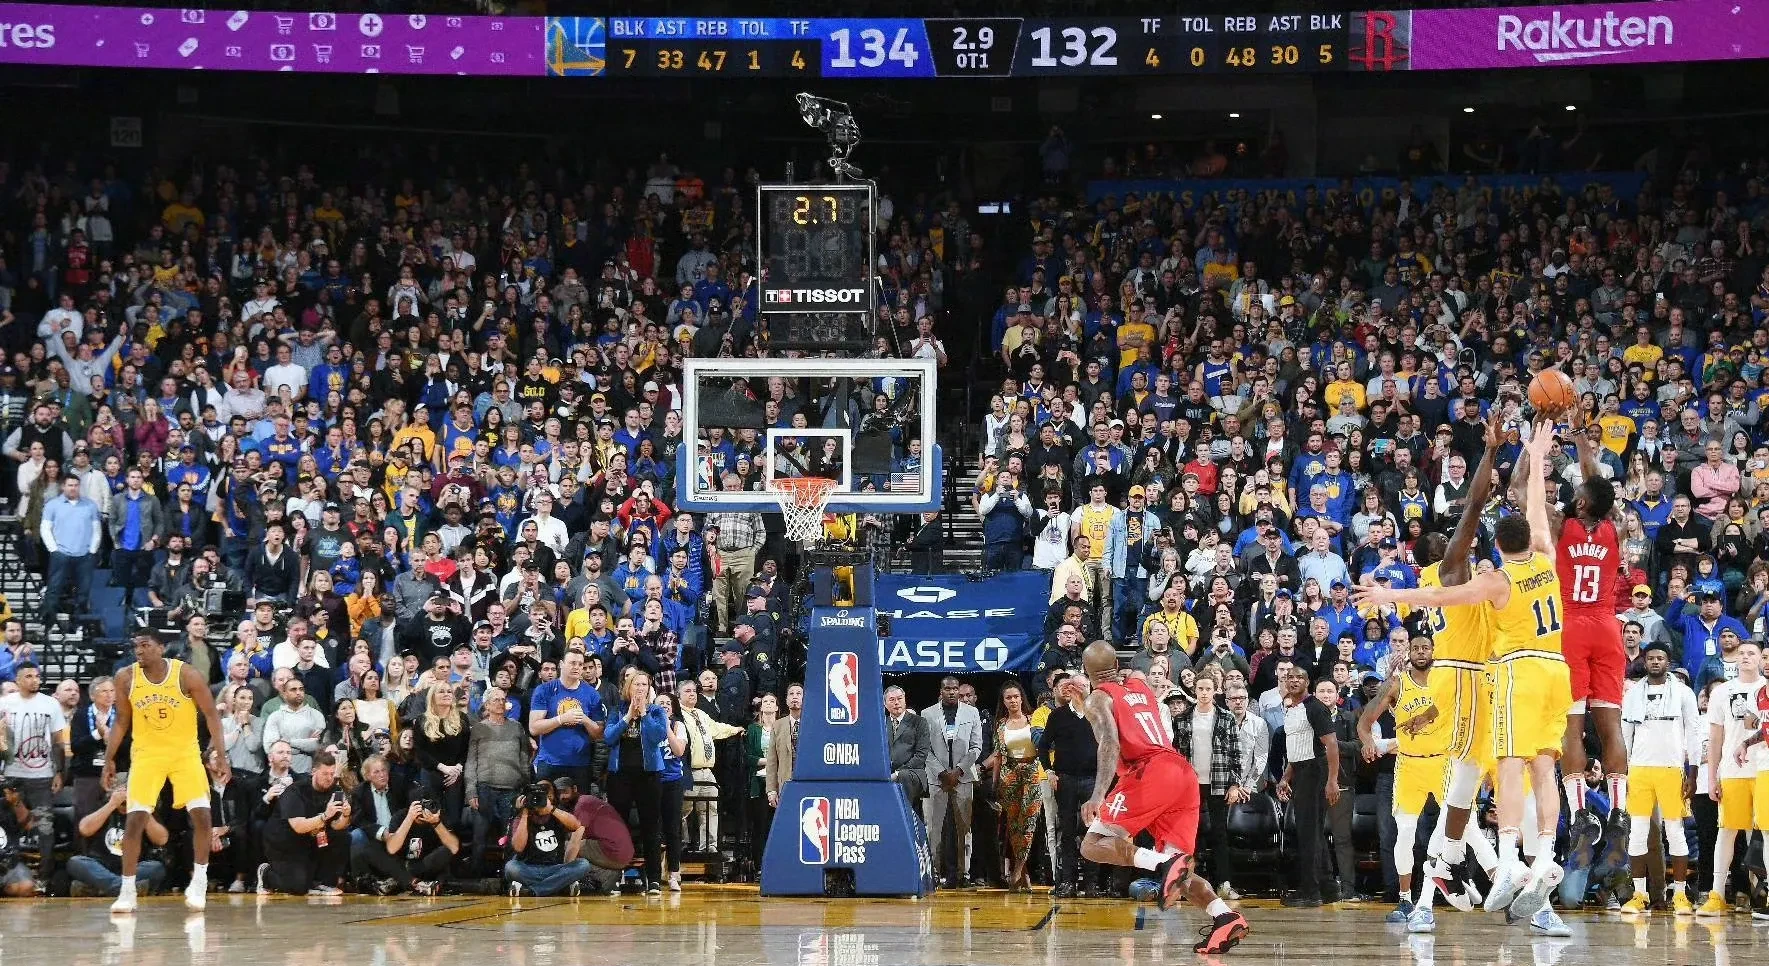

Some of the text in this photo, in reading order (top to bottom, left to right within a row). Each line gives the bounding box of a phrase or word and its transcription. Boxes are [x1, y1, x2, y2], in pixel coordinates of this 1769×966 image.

[613, 20, 810, 36] BLK AST REB TOL TF
[1140, 14, 1342, 34] TF TOL REB AST BLK
[1497, 11, 1674, 51] Rakuten
[829, 27, 919, 68] 134
[952, 26, 994, 50] 2.9
[1030, 26, 1118, 67] 132
[622, 49, 807, 71] 7 33 47 1 4
[1145, 44, 1334, 67] 4 0 48 30 5
[793, 196, 837, 225] 2.7
[792, 289, 865, 303] TISSOT
[1567, 543, 1609, 561] HARDEN
[1515, 569, 1556, 594] THOMPSON
[1571, 564, 1601, 603] 13
[820, 616, 865, 628] SPALDING
[875, 608, 1016, 619] HASE
[1531, 595, 1561, 637] 11
[878, 640, 967, 668] ASE
[158, 707, 168, 719] 5
[830, 707, 846, 720] NBA
[1133, 711, 1164, 746] 17
[823, 742, 860, 766] @NBA
[834, 798, 860, 820] NBA
[834, 823, 880, 846] League
[834, 842, 866, 864] Pass
